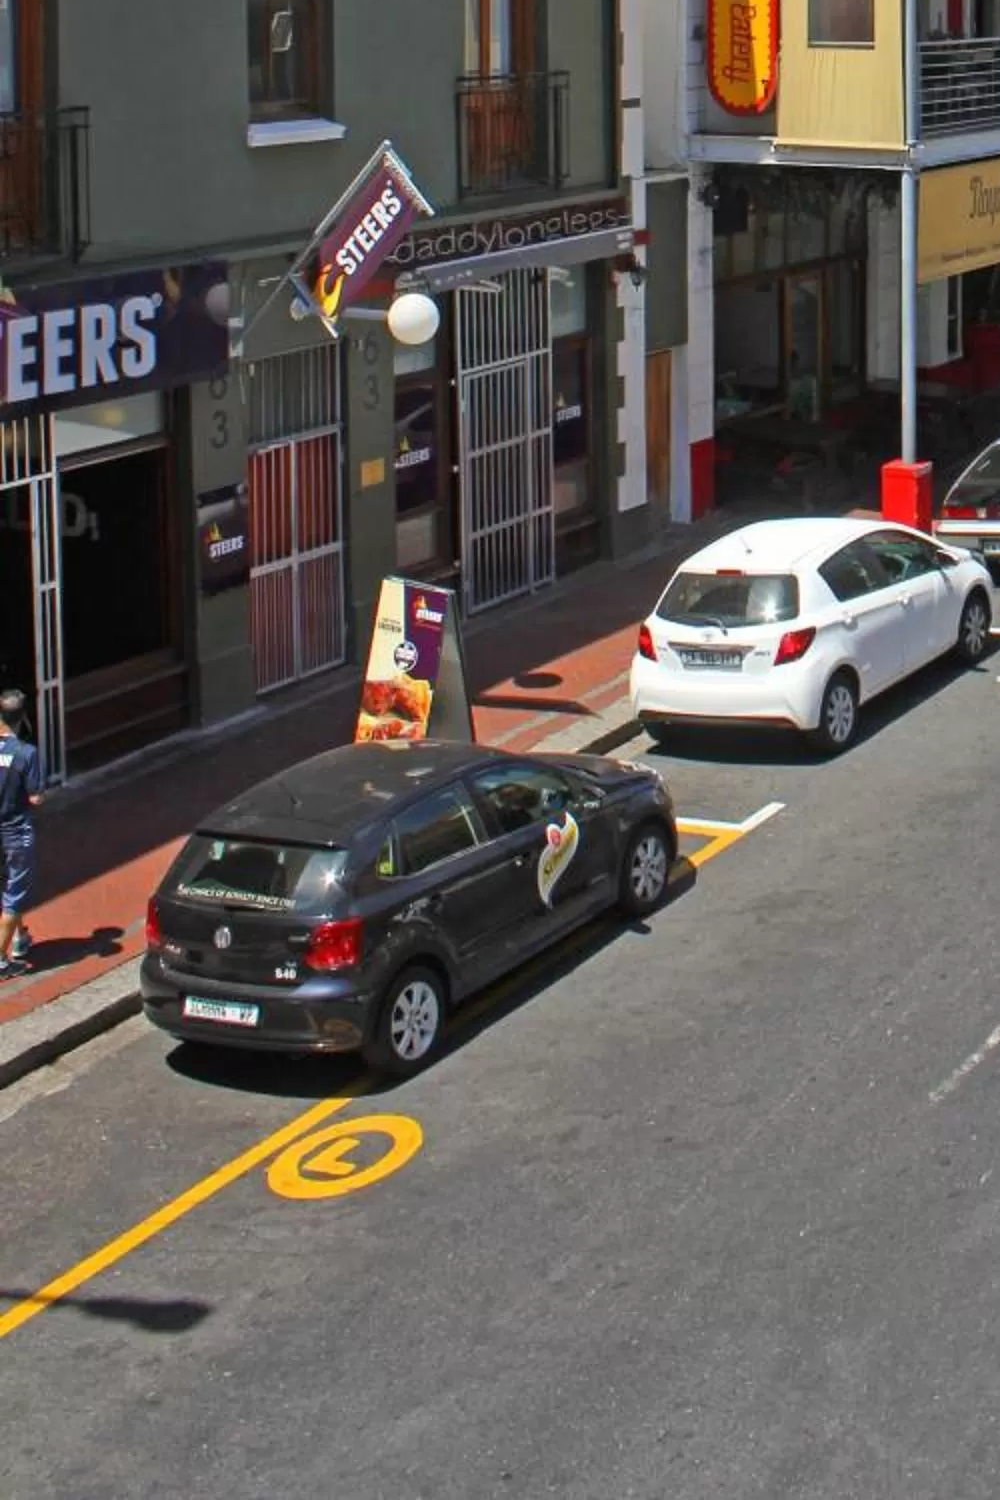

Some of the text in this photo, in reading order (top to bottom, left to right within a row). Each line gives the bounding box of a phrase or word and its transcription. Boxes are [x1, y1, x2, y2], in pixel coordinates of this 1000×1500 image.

[722, 3, 757, 85] Eatery
[336, 187, 402, 276] STEERS
[0, 296, 157, 404] EERS
